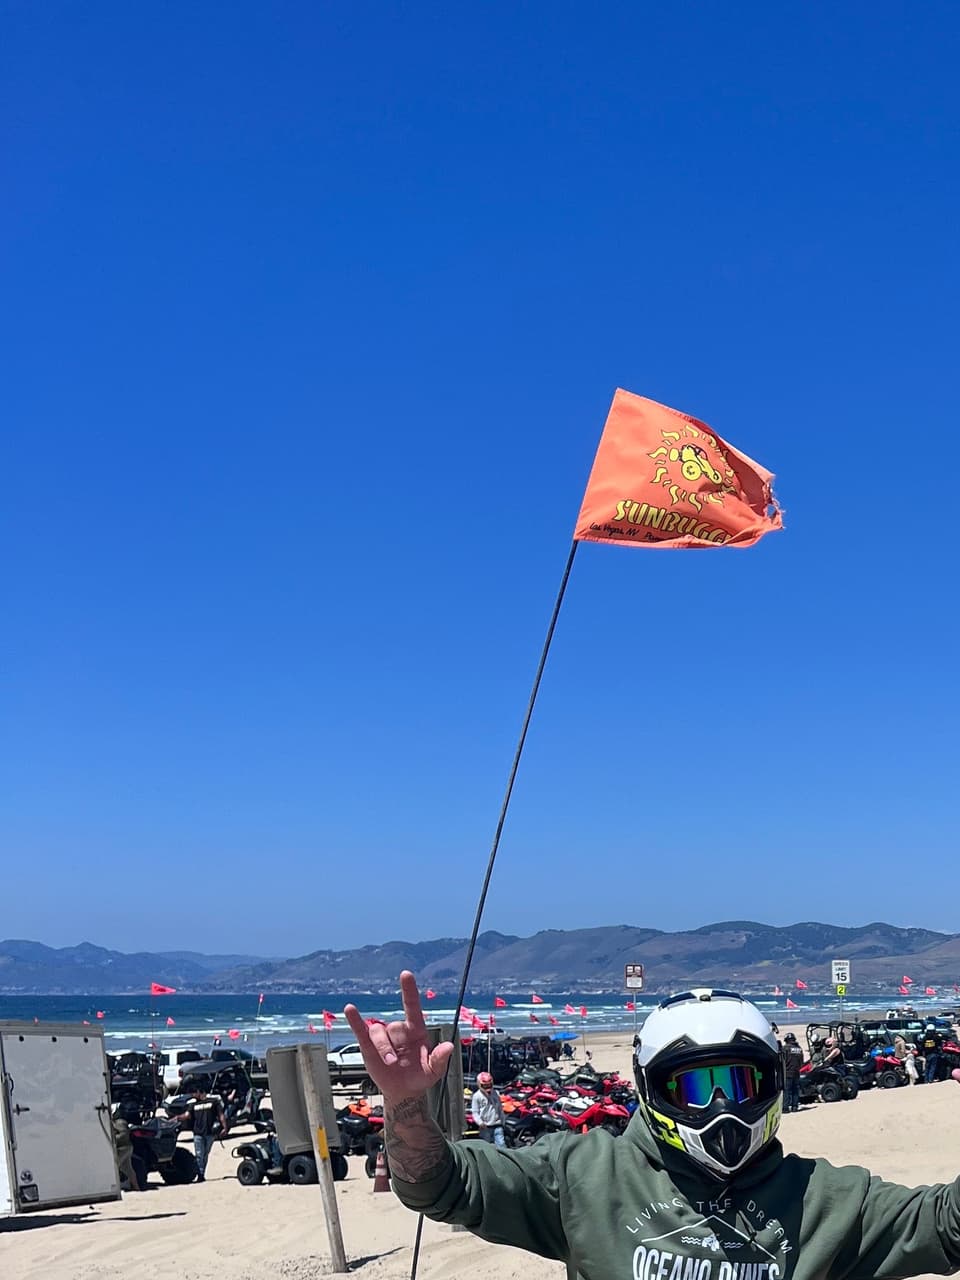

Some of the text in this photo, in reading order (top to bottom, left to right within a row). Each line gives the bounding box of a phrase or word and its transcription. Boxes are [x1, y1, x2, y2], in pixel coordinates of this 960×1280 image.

[836, 972, 847, 981] 15
[838, 986, 844, 994] 2
[626, 1197, 793, 1254] LIVING THE DREAM
